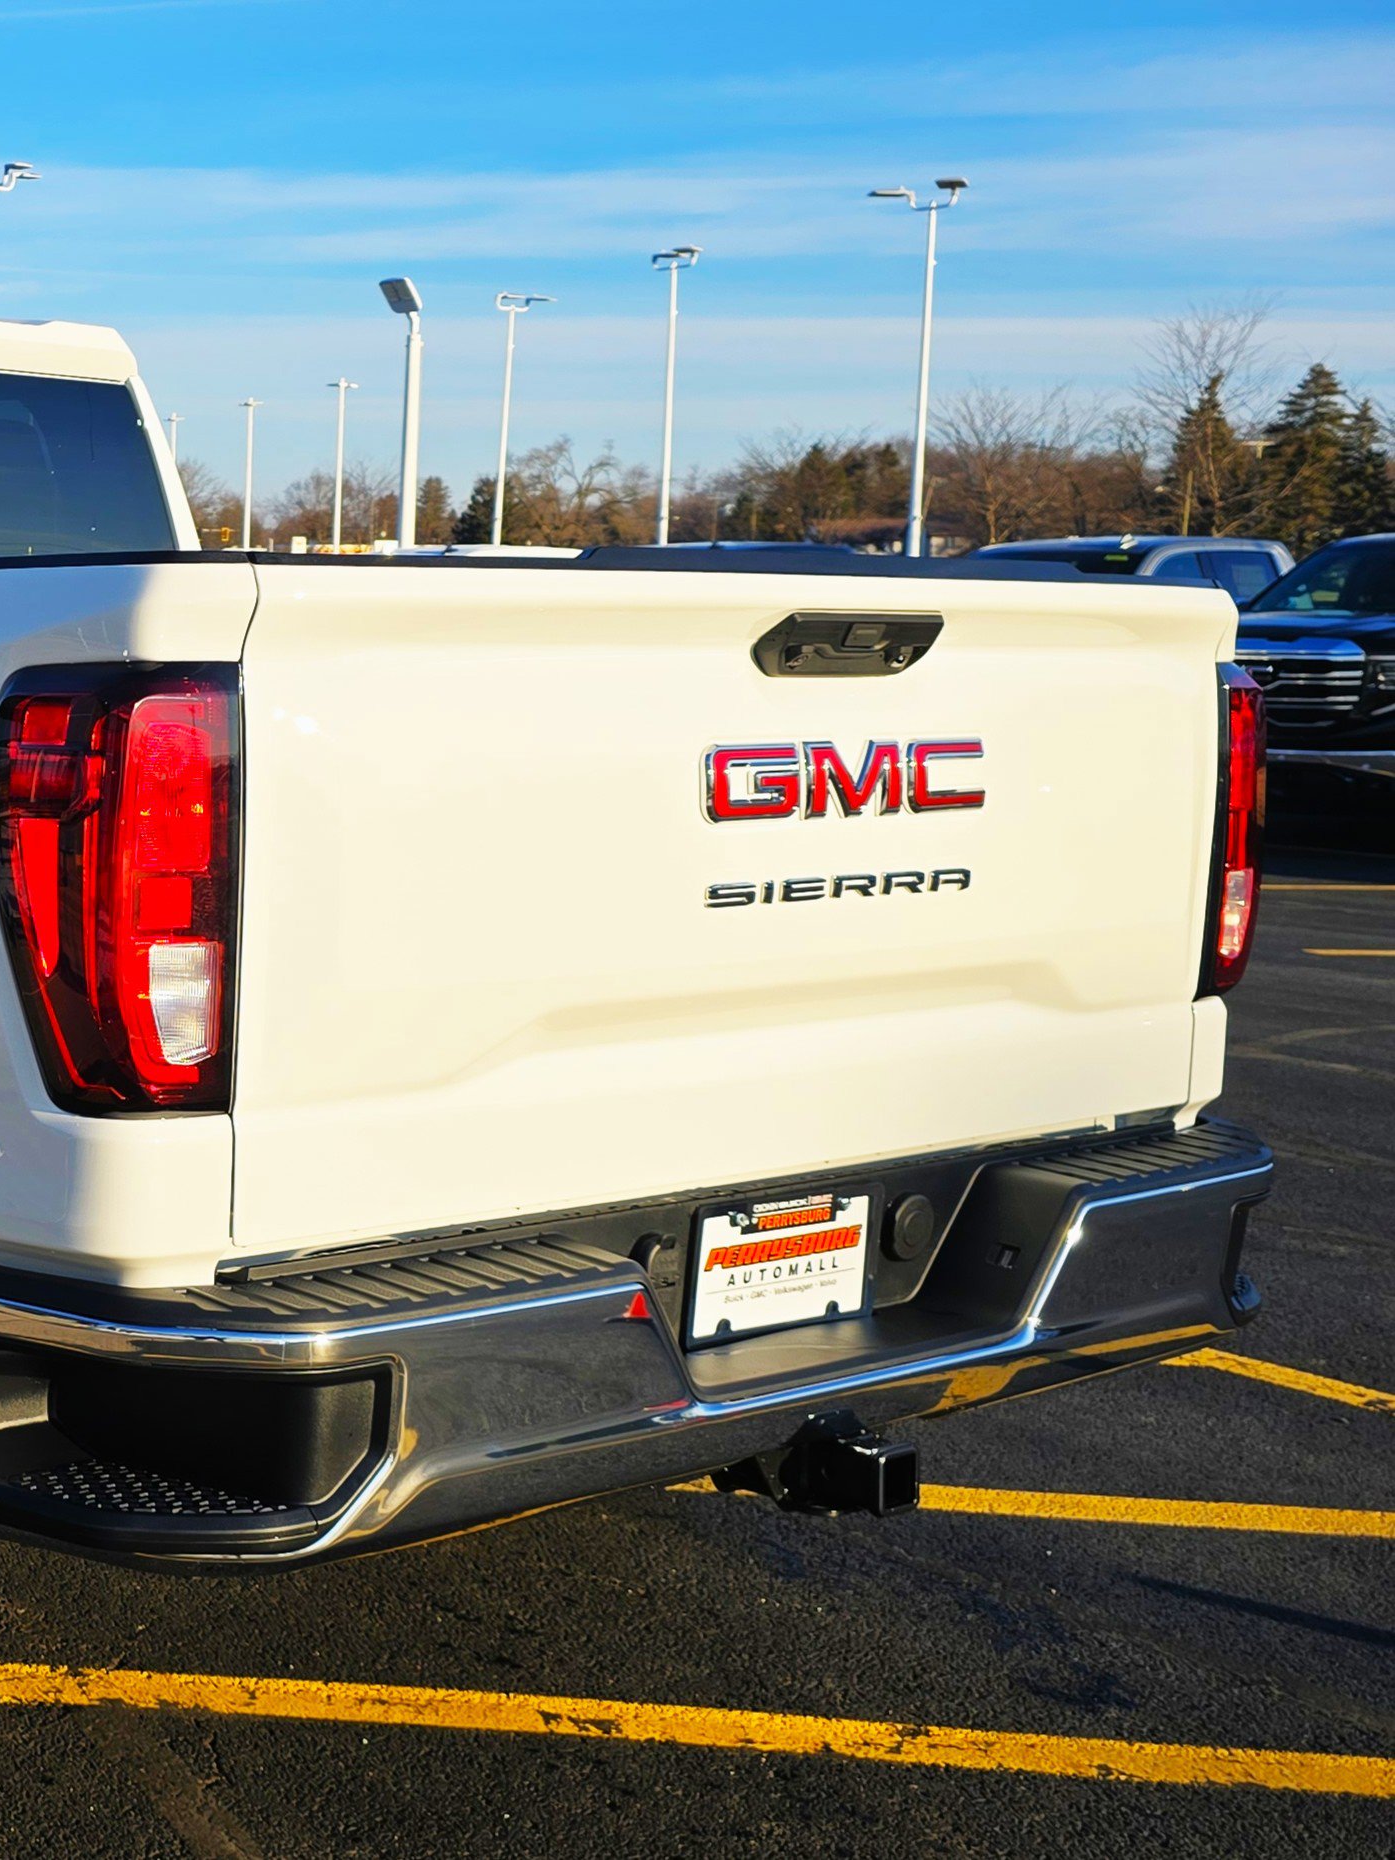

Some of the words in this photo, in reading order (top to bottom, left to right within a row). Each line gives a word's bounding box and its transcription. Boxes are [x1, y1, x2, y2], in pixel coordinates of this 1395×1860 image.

[703, 737, 986, 822] GMC
[704, 868, 972, 908] SIERRA
[758, 1208, 831, 1230] PERRYSBURG
[704, 1224, 863, 1272] PERRYSBURG
[727, 1257, 839, 1287] AUTOMALL
